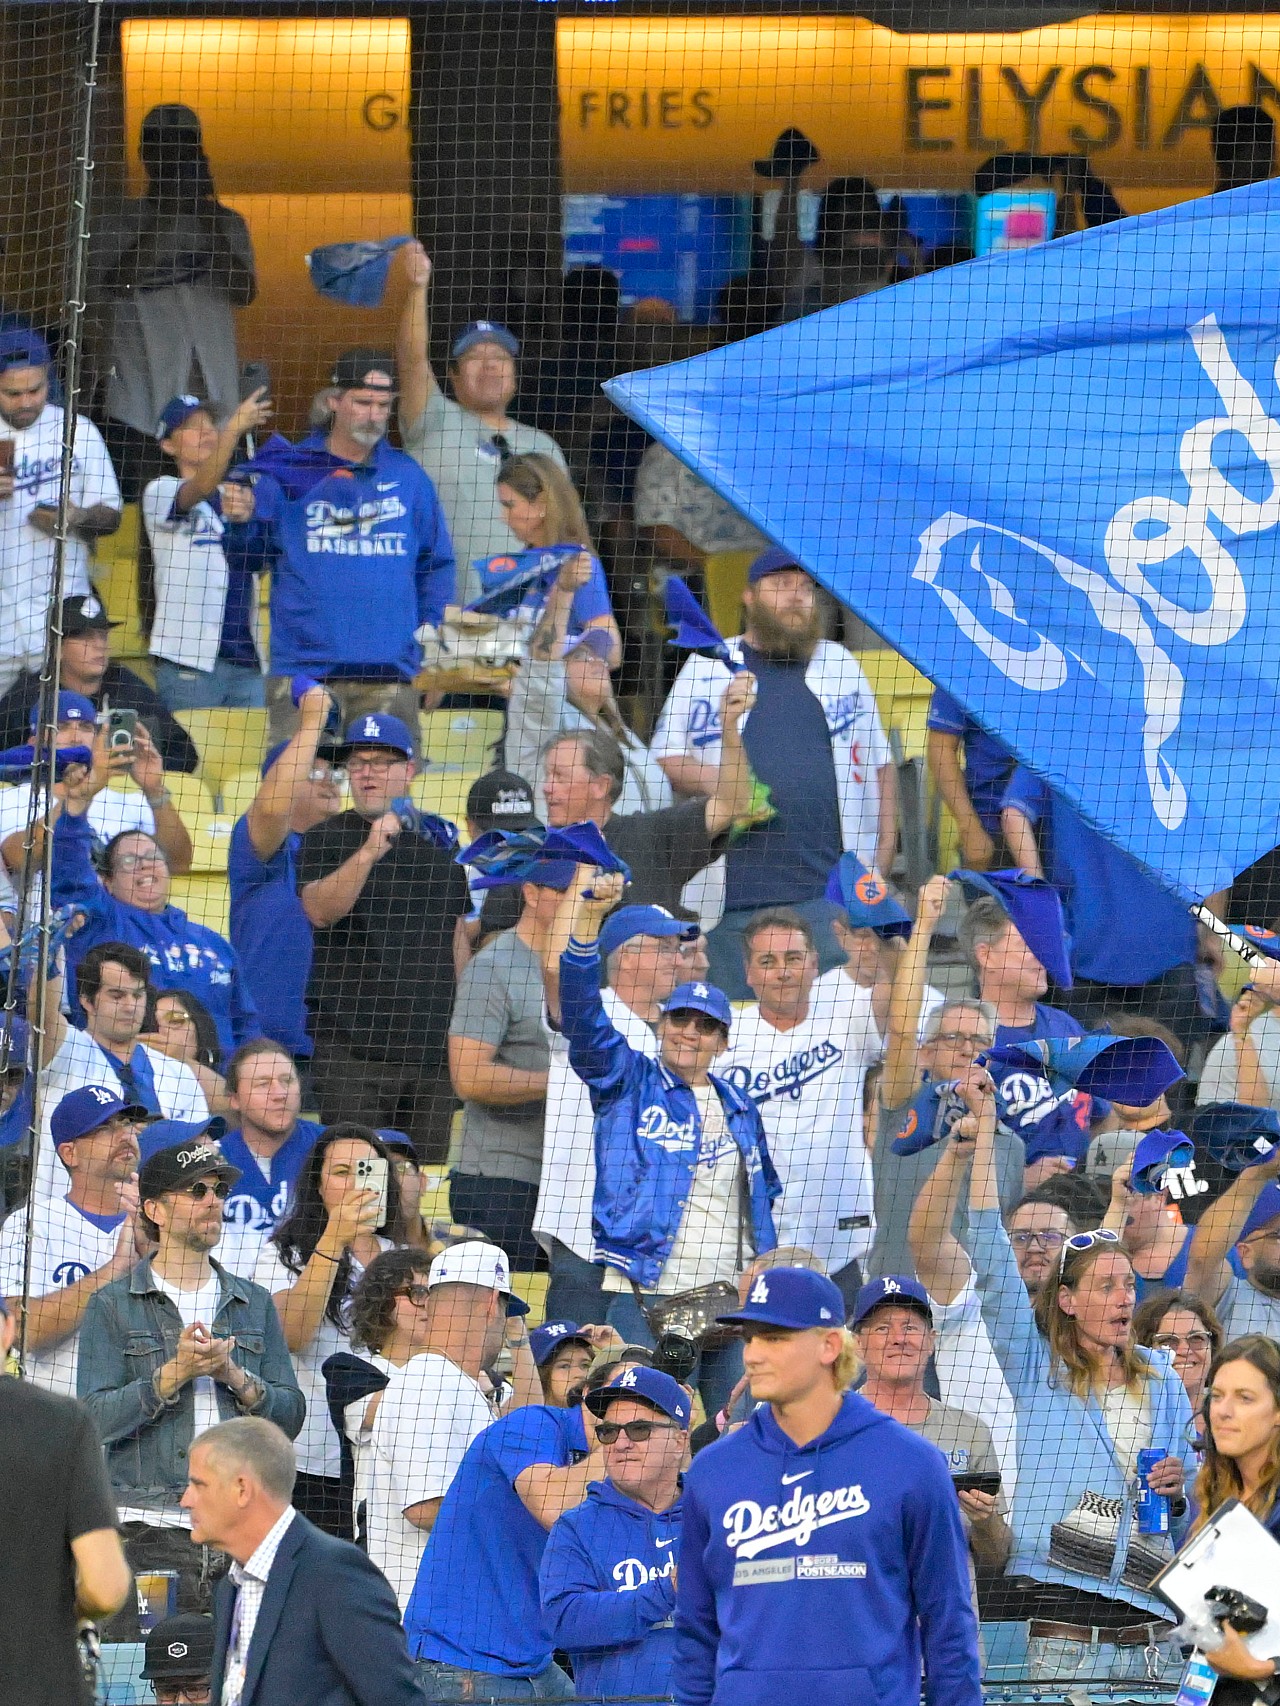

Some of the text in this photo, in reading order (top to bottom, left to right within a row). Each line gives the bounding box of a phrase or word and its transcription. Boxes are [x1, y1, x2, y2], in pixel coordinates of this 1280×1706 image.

[578, 90, 716, 130] FRIES
[306, 536, 406, 556] BASEBALL
[363, 716, 381, 737] LA
[721, 1038, 843, 1106] Dodgers
[88, 1087, 115, 1106] LA
[750, 1274, 770, 1304] LA
[881, 1276, 903, 1295] LA
[620, 1368, 638, 1388] LA
[723, 1483, 870, 1559] Dodgers
[797, 1564, 867, 1578] POSTSEASON
